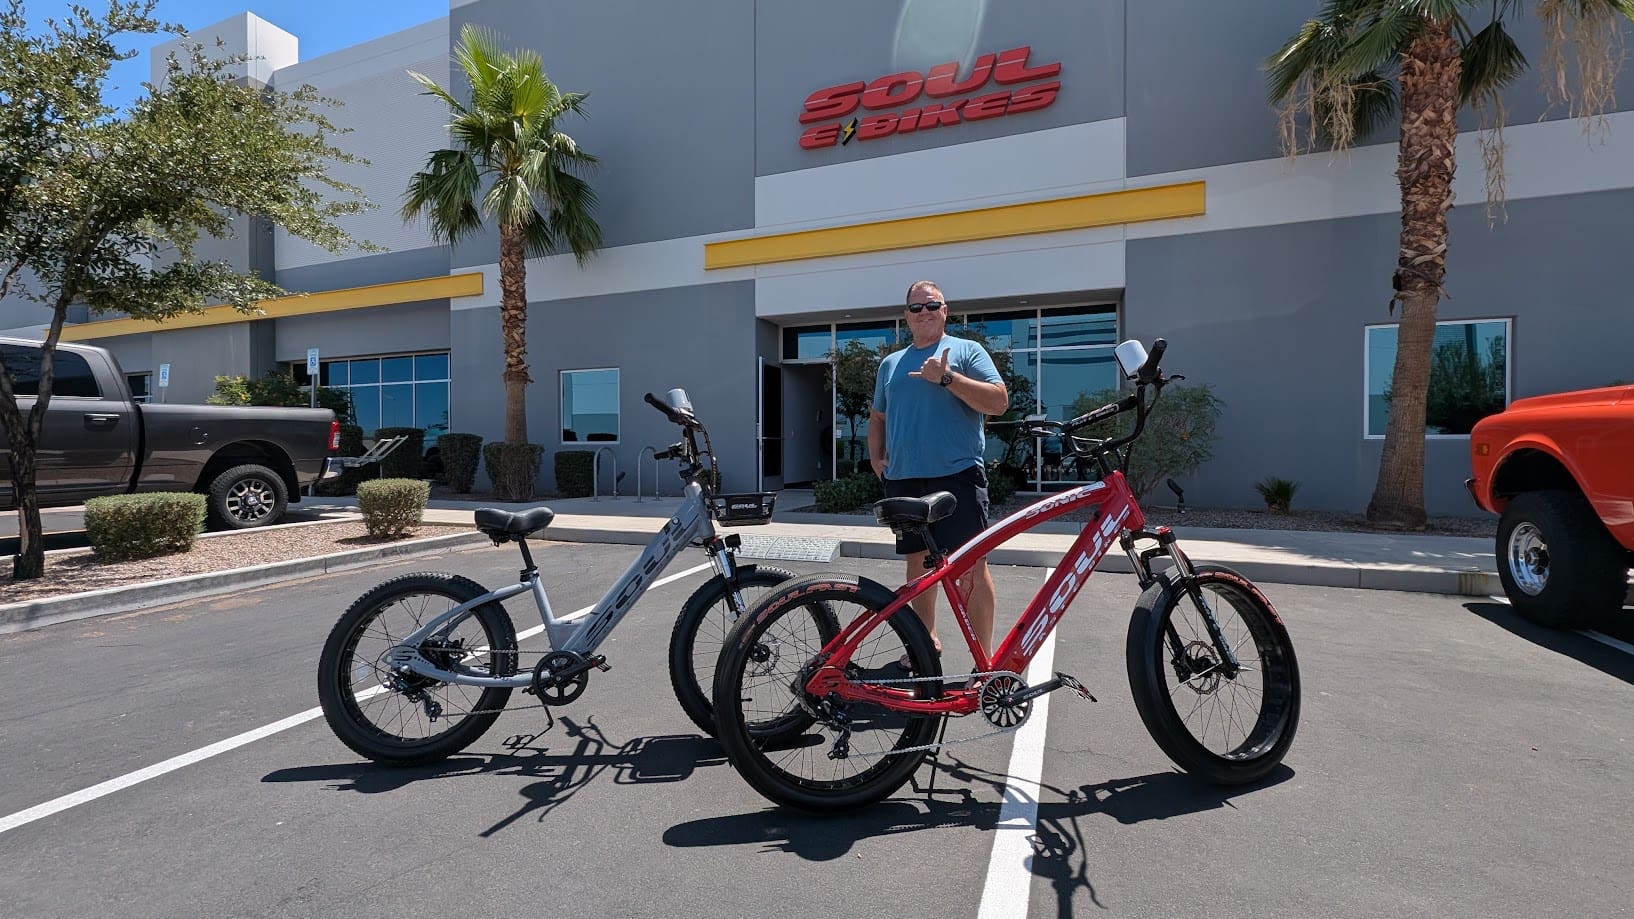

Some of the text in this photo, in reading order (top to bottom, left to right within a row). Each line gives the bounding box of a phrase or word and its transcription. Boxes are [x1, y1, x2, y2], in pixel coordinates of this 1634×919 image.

[799, 46, 1061, 124] SOUL
[799, 80, 1061, 150] E BIKES
[1024, 491, 1092, 520] SONIC
[586, 513, 700, 647] SOUL
[756, 590, 805, 624] SOUL
[1020, 504, 1130, 657] SOUL
